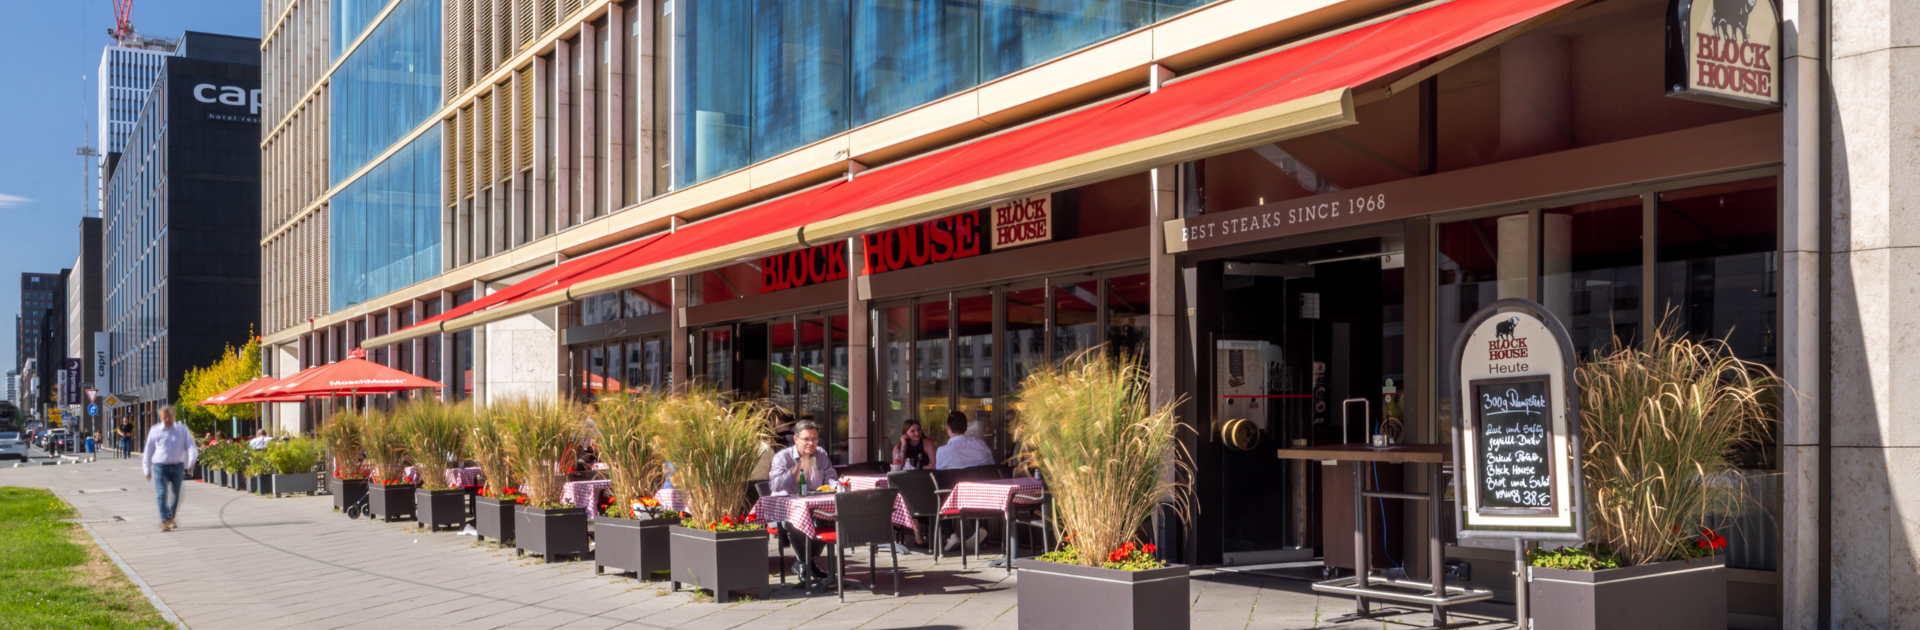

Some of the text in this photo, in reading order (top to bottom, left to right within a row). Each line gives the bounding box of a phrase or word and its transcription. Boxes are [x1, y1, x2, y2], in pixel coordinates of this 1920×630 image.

[1696, 32, 1771, 71] BLOCK
[1696, 59, 1771, 97] HOUSE
[209, 113, 237, 121] hotel
[996, 198, 1047, 227] BLOCK
[1181, 193, 1386, 242] BEST STEAKS SINCE 1968
[997, 218, 1047, 246] HOUSE
[760, 209, 981, 293] BLOCK HOUSE
[1488, 337, 1528, 351] BLOCK
[1488, 347, 1529, 361] HOUSE
[1489, 361, 1529, 374] Heute
[1483, 393, 1509, 413] 300g
[1505, 422, 1521, 434] und
[1486, 452, 1512, 465] Baked
[1486, 463, 1535, 477] Block House
[1485, 476, 1507, 491] Brot
[1510, 477, 1527, 488] und
